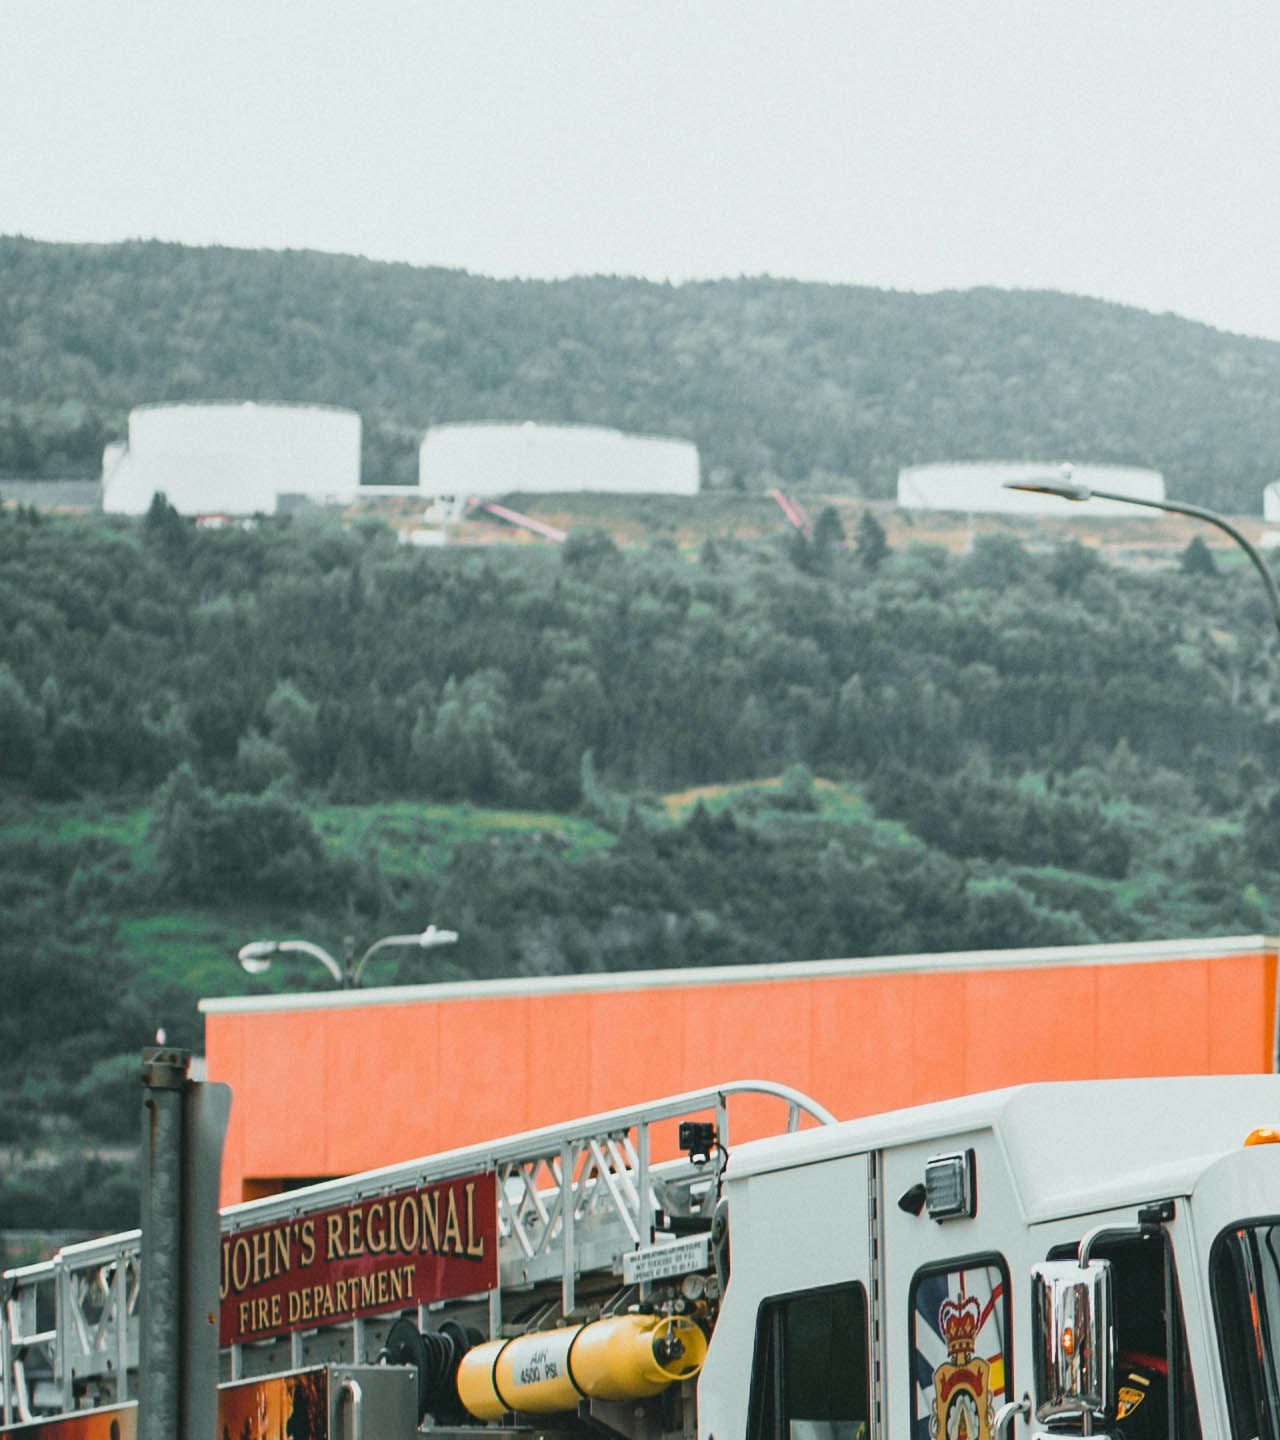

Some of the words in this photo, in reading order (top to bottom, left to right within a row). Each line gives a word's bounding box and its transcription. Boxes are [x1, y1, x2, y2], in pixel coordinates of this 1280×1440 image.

[219, 1219, 315, 1300] JOHN'S
[326, 1183, 485, 1260] REGIONAL
[239, 1294, 283, 1334] FIRE
[287, 1264, 416, 1323] DEPARTMENT
